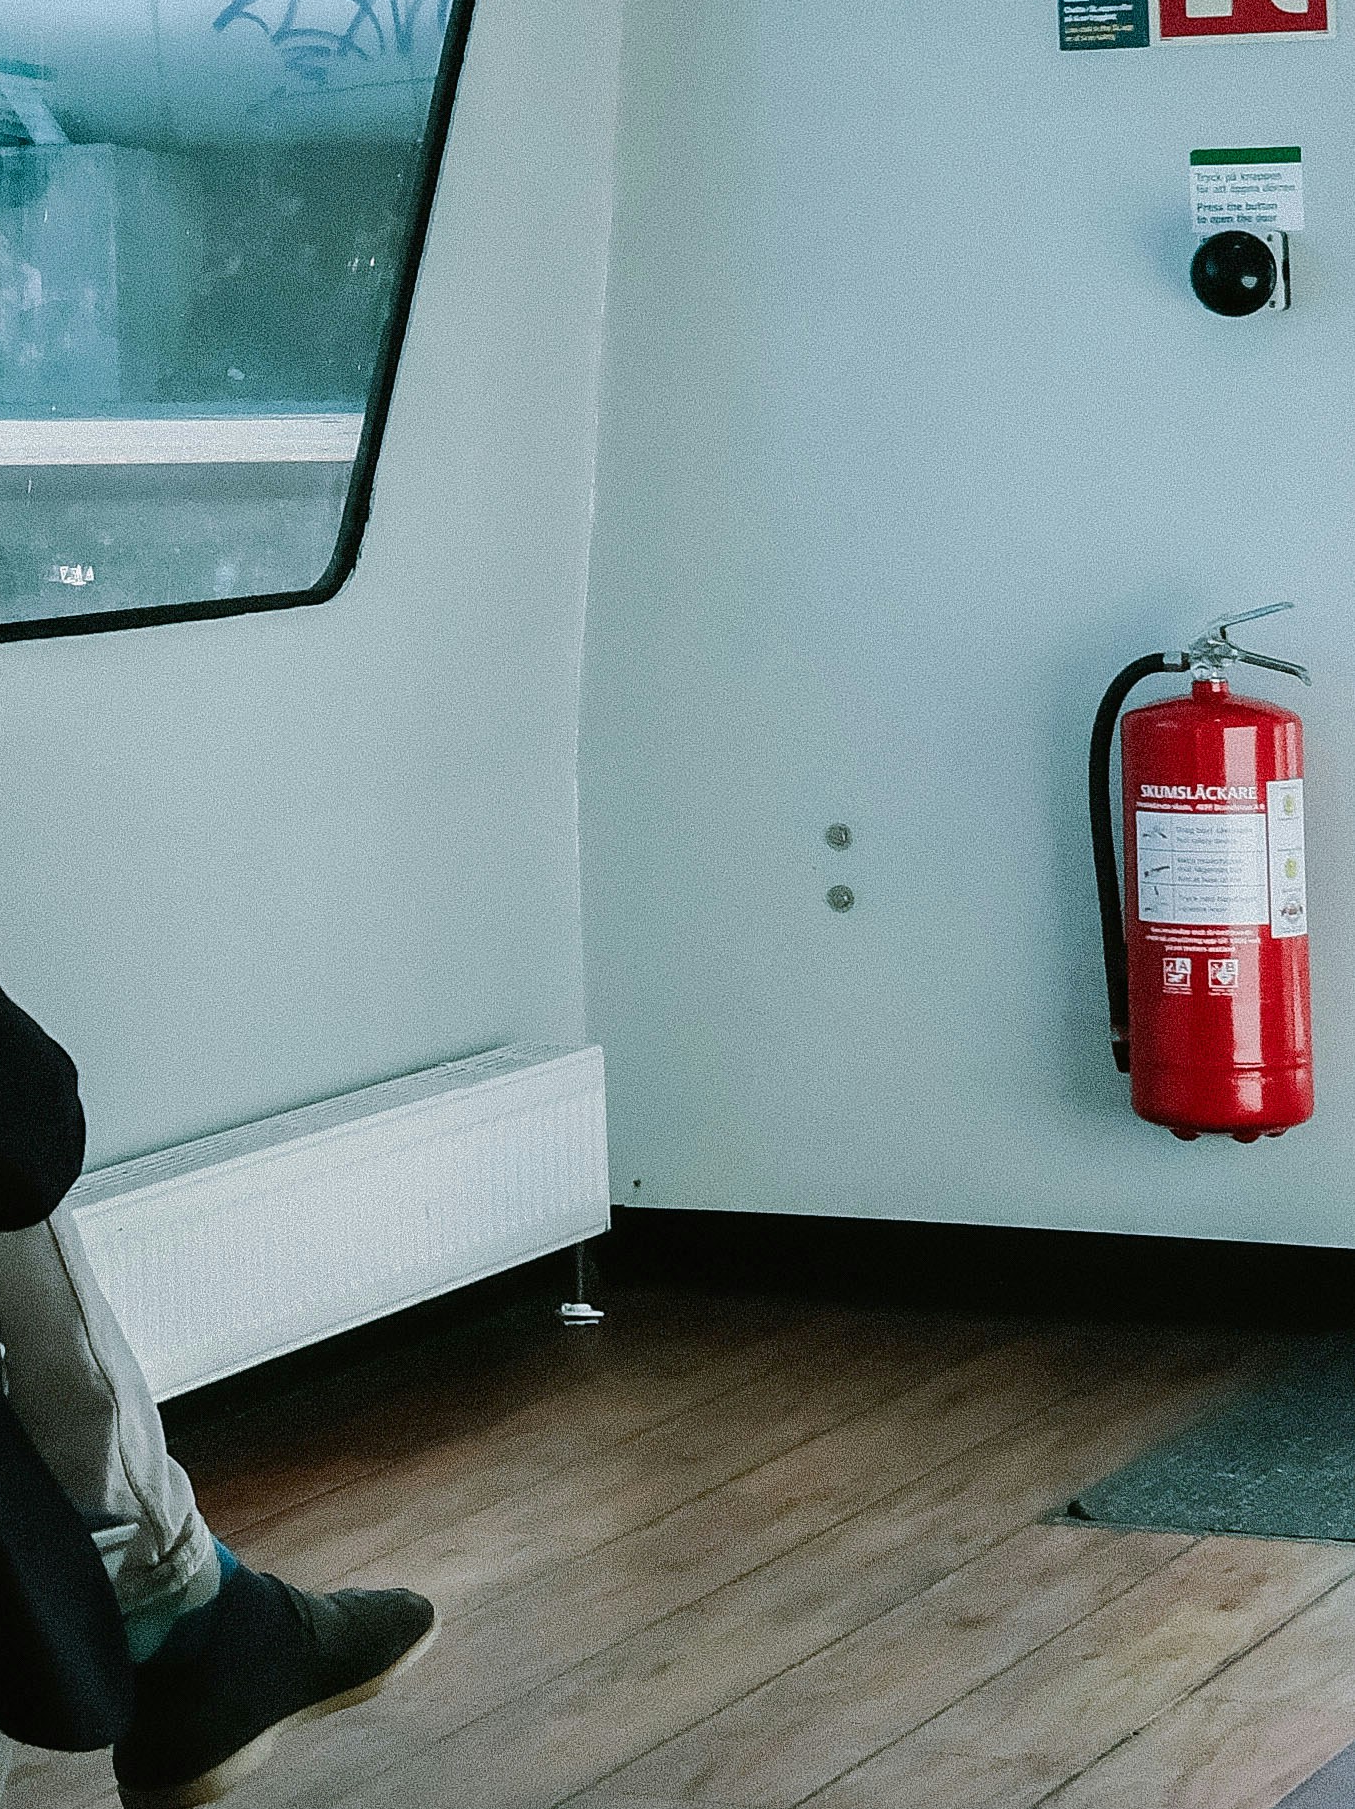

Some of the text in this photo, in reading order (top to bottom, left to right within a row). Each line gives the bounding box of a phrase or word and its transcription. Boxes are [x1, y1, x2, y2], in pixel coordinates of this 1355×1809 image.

[1196, 172, 1221, 183] Tryck
[1226, 172, 1236, 183] på
[1197, 202, 1278, 212] Press the button
[1197, 214, 1277, 225] to open the door
[1179, 961, 1189, 971] A
[1226, 962, 1236, 972] B
